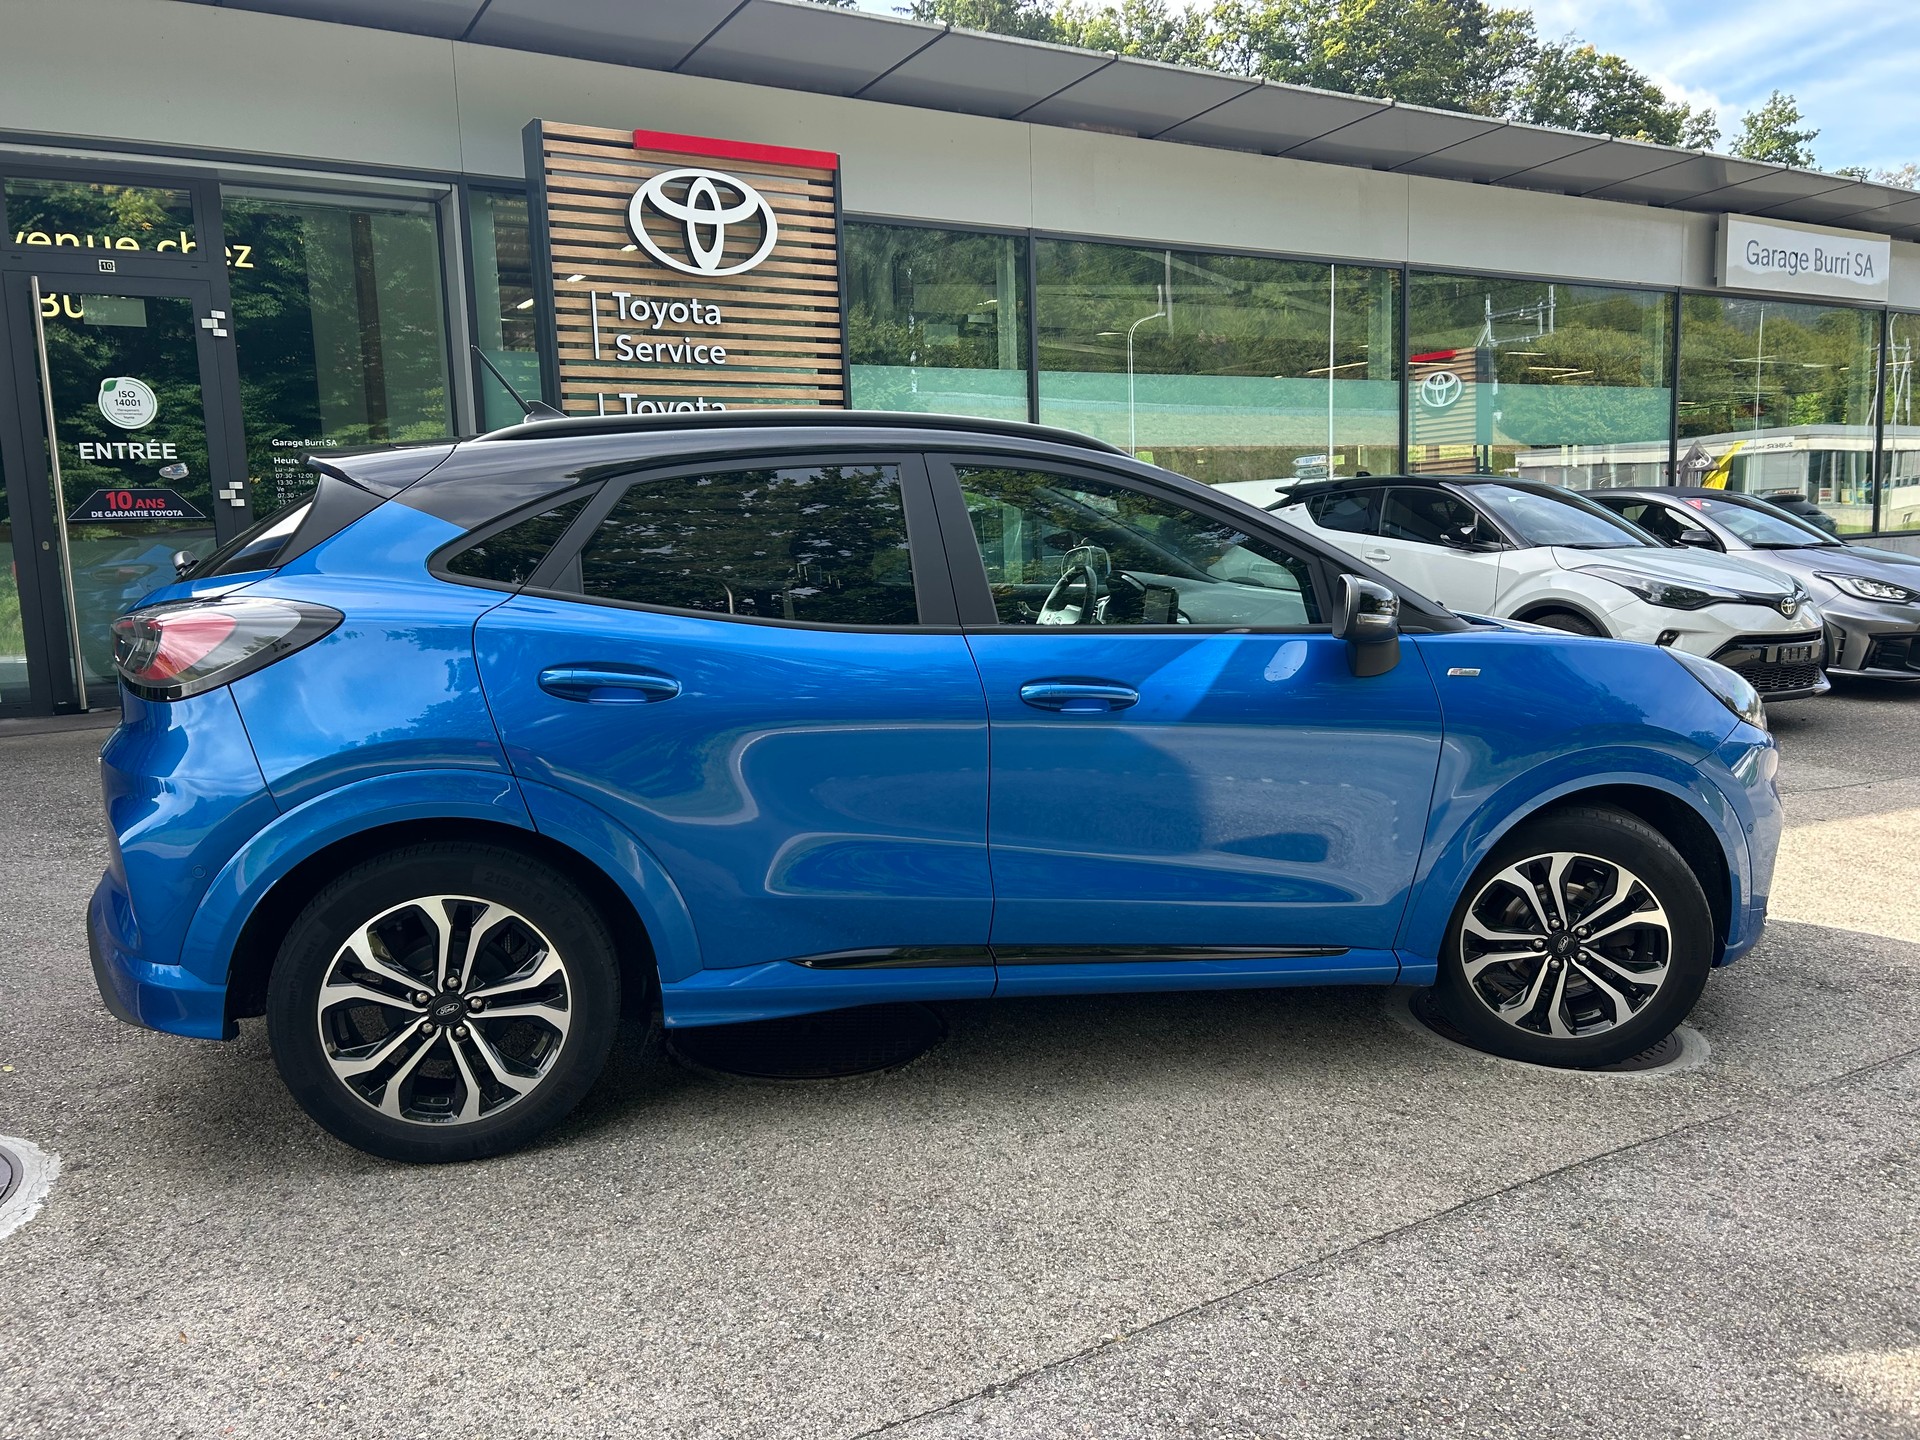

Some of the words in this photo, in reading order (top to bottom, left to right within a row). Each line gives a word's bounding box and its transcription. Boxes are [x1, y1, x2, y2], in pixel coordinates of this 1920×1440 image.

[1746, 239, 1809, 276] Garage
[1814, 247, 1850, 275] Burri
[1854, 253, 1874, 278] SA
[101, 261, 112, 271] 10
[612, 291, 722, 330] Toyota
[616, 334, 727, 365] Service
[118, 390, 136, 398] ISO
[114, 399, 141, 407] 14001
[79, 439, 178, 460] ENTRÉE
[272, 438, 303, 448] Garage
[105, 491, 133, 510] 10
[135, 499, 166, 509] ANS
[104, 510, 149, 518] GARANTIE
